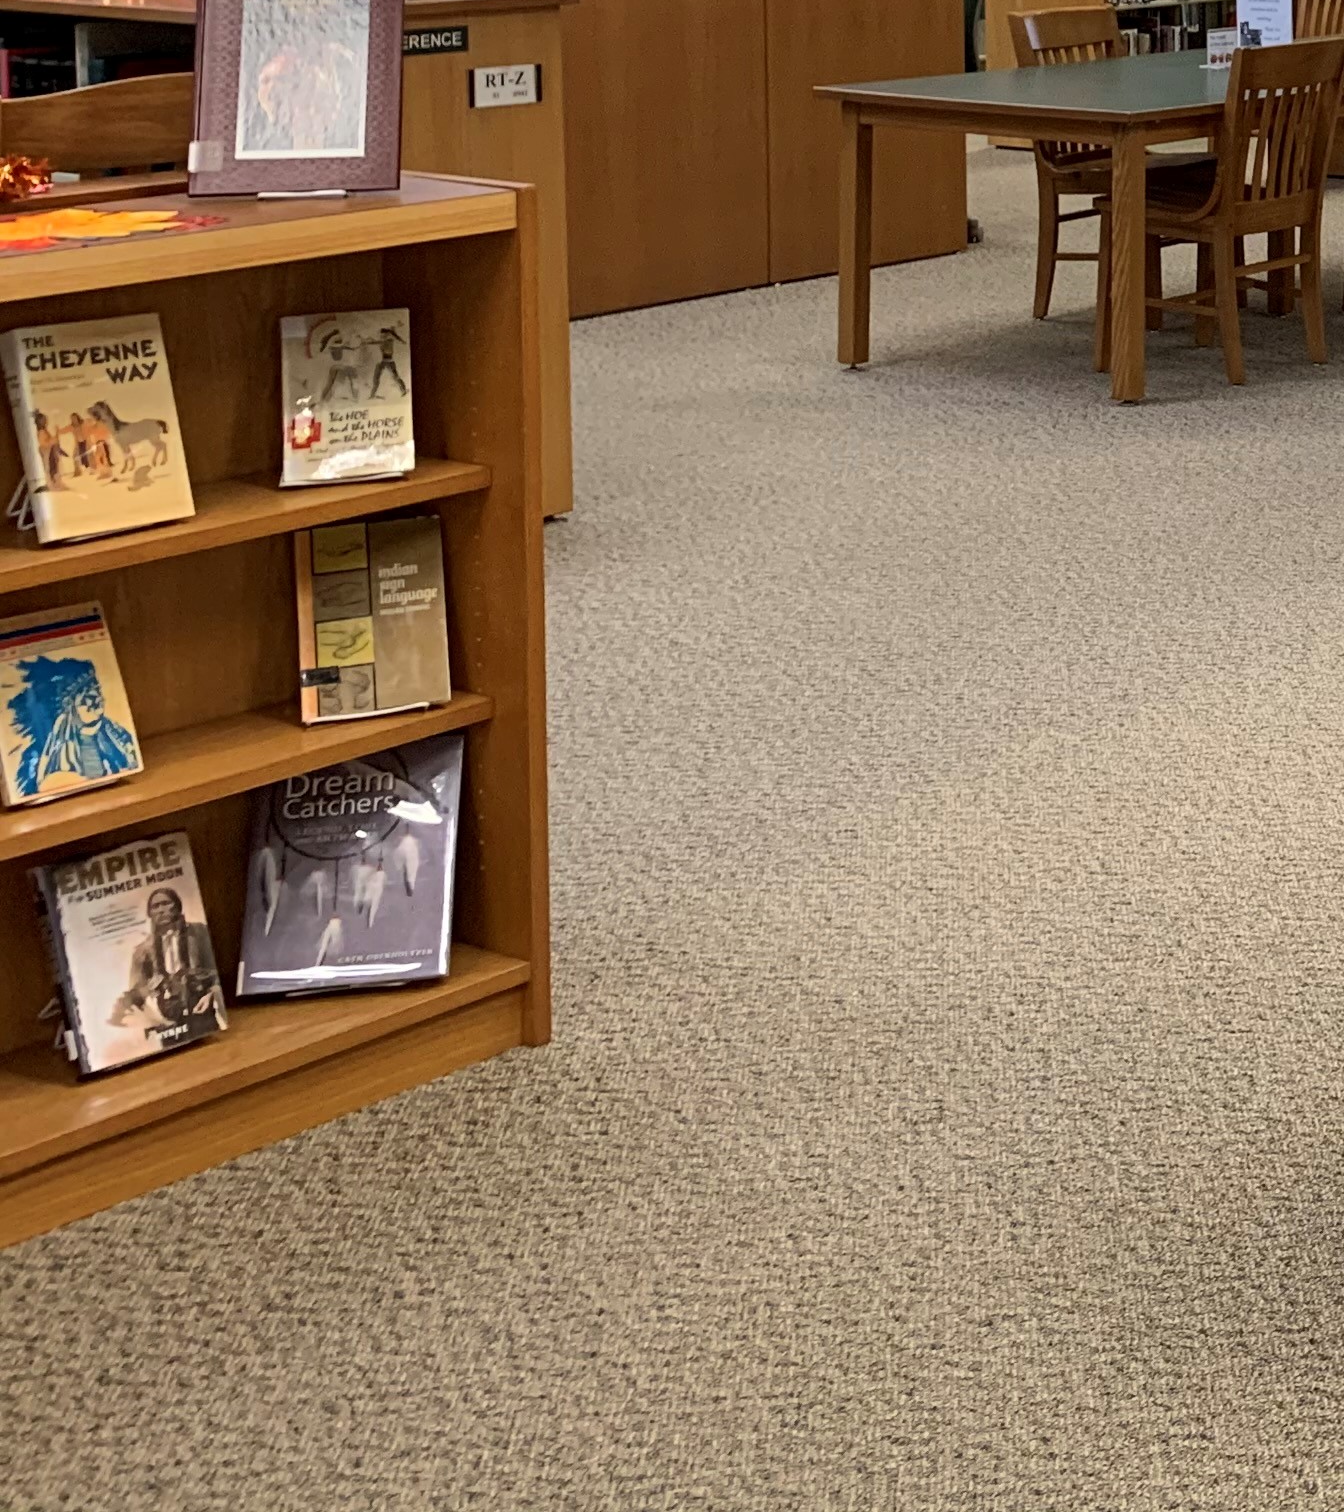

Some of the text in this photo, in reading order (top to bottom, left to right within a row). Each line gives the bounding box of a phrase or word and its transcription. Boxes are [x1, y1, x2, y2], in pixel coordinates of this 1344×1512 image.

[485, 71, 527, 88] RT-Z
[22, 335, 55, 349] THE
[25, 339, 158, 372] CHEYENNE
[105, 361, 158, 384] WAY
[345, 409, 369, 420] HOE
[367, 416, 405, 428] HORSE
[361, 429, 400, 441] PLAINS
[379, 588, 439, 605] language
[285, 771, 395, 799] Dream
[282, 794, 395, 820] Catchers
[59, 840, 181, 895] EMPIRE
[86, 878, 142, 902] SUMMER
[145, 867, 184, 885] MOON
